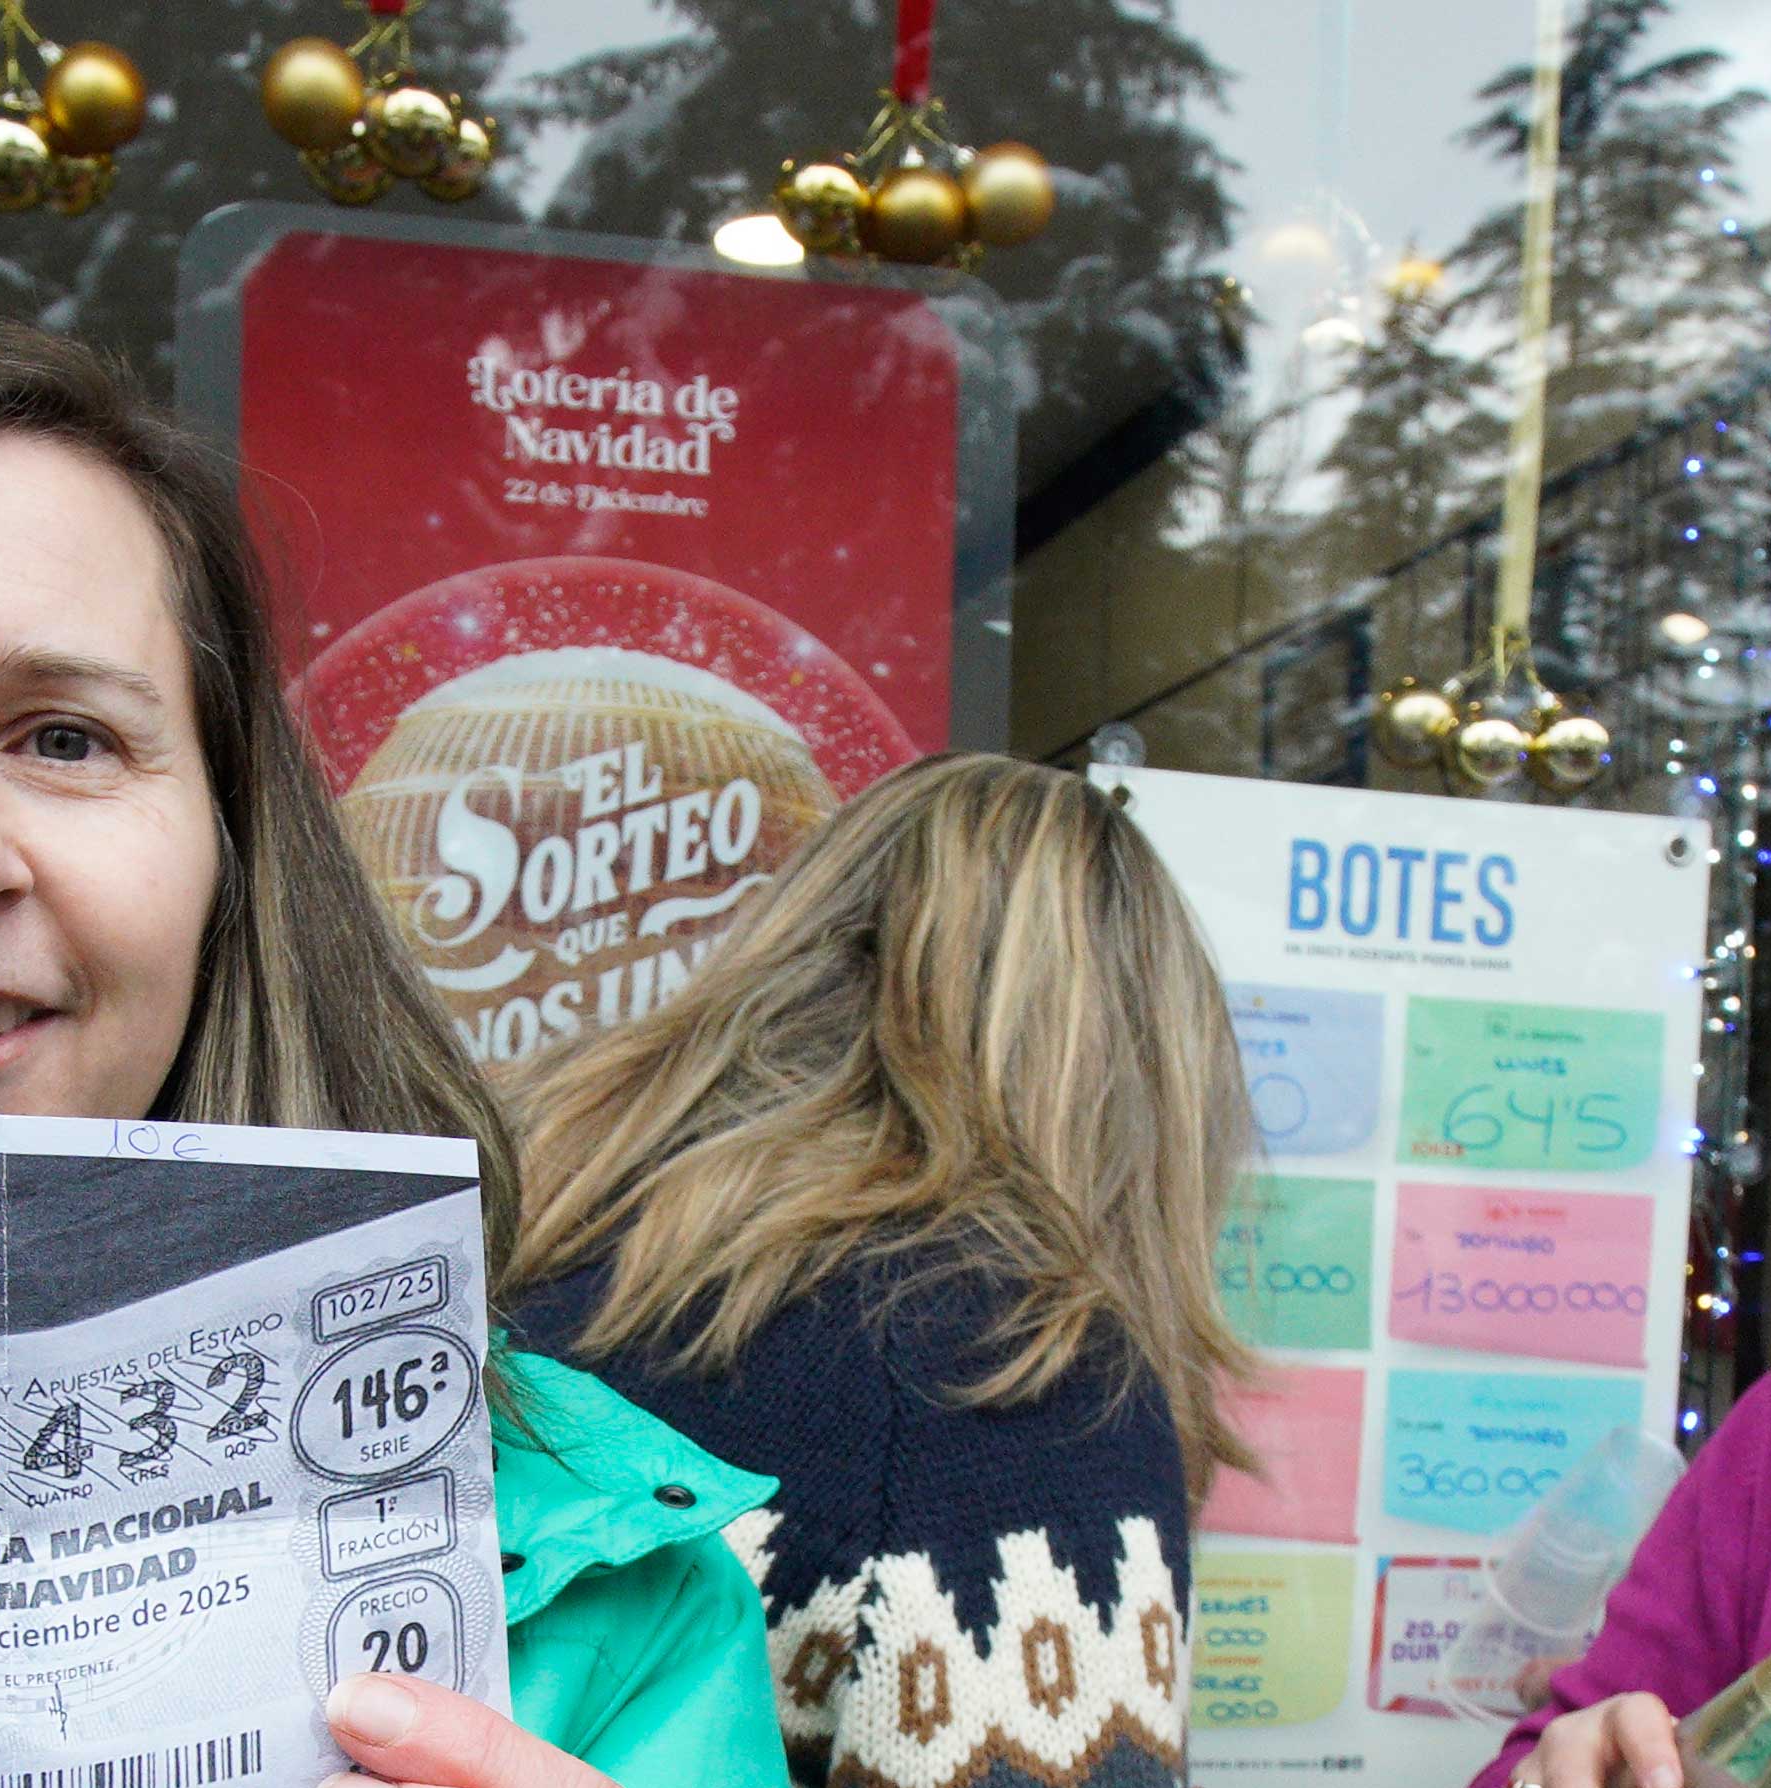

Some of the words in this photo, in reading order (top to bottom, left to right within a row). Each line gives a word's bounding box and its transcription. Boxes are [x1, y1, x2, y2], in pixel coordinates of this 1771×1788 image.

[674, 374, 740, 420] de
[503, 415, 736, 476] Navidad
[503, 477, 537, 504] 22
[539, 480, 572, 506] de
[563, 740, 663, 819] EL
[414, 765, 762, 949] SORTEO
[1288, 837, 1518, 947] BOTES
[546, 912, 628, 967] QUE
[597, 928, 728, 1030] UN
[329, 1268, 434, 1320] 102/25
[23, 1358, 139, 1400] APUESTAS
[147, 1345, 184, 1371] DEL
[189, 1312, 284, 1355] ESTADO
[27, 1482, 94, 1507] CUATRO
[129, 1463, 170, 1485] TRES
[223, 1438, 258, 1461] DOS
[359, 1434, 412, 1463] SERIE
[49, 1480, 274, 1560] NACIONAL
[337, 1518, 439, 1560] FRACCIÓN
[131, 1596, 168, 1628] de
[178, 1573, 252, 1618] 2025
[359, 1585, 429, 1619] PRECIO
[362, 1621, 429, 1674] 20
[4, 1673, 23, 1688] EL
